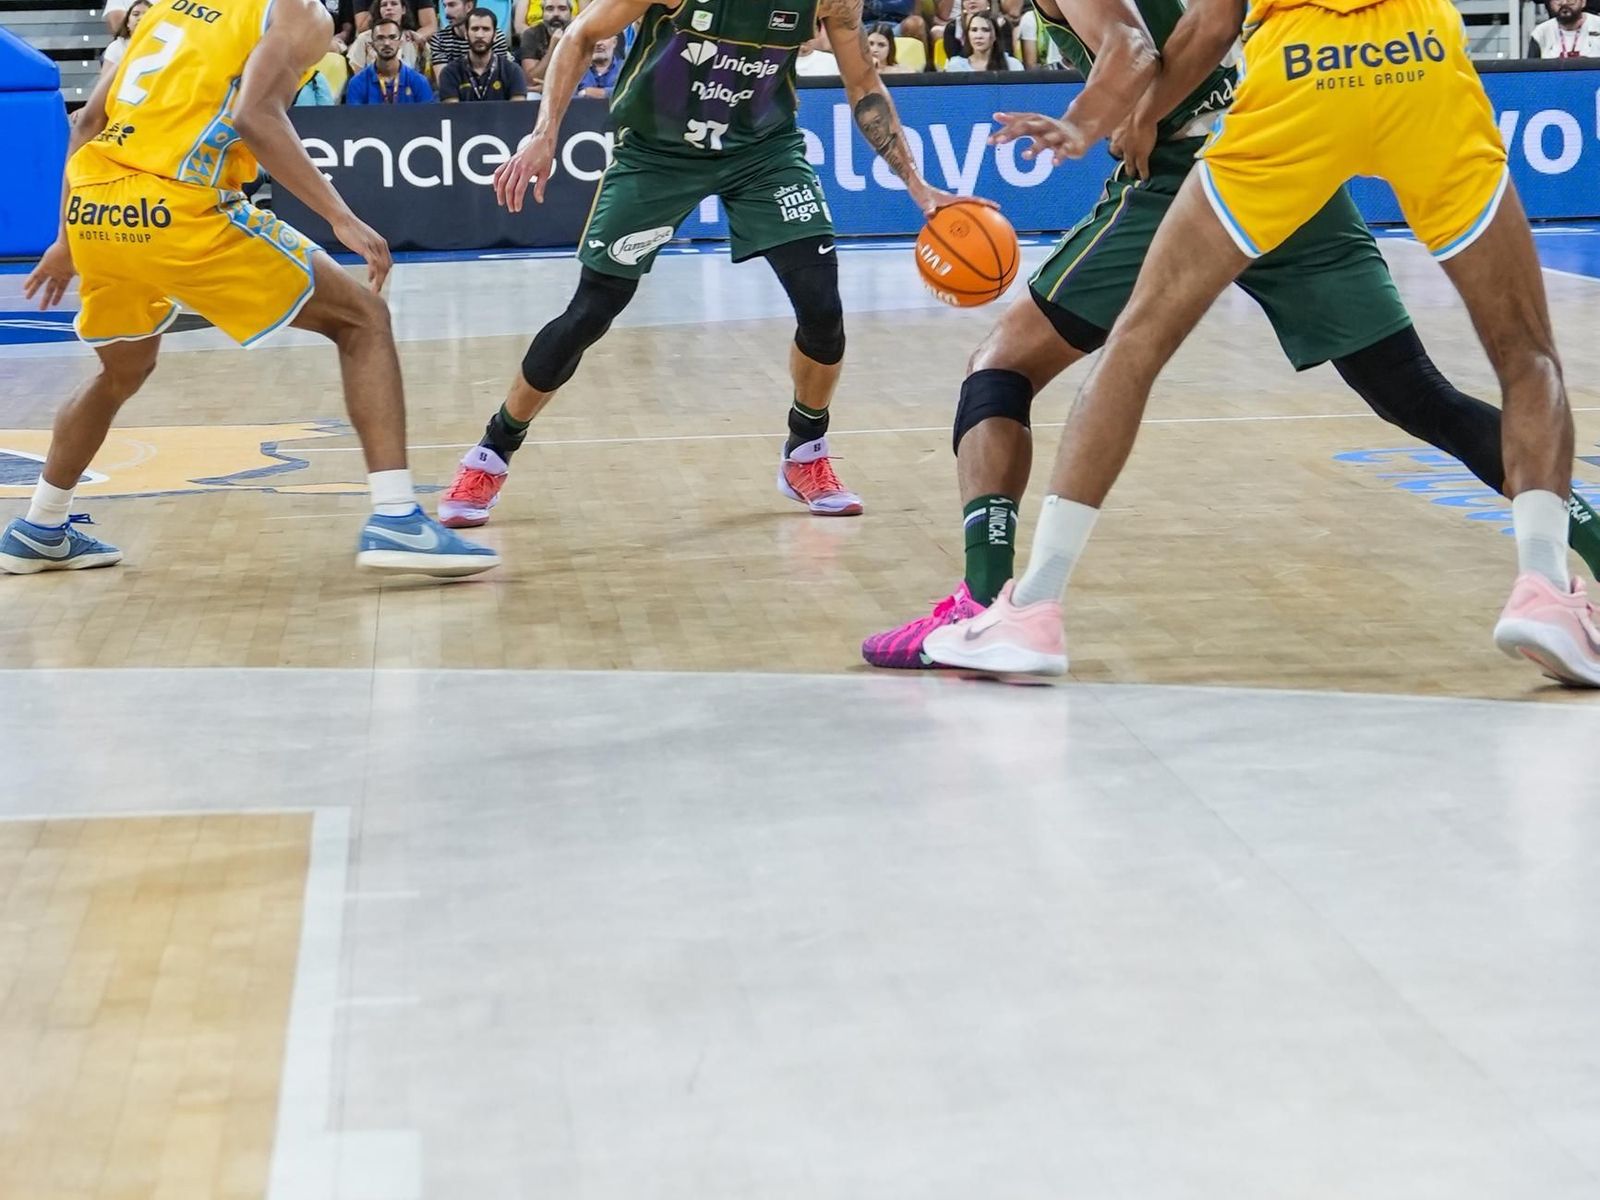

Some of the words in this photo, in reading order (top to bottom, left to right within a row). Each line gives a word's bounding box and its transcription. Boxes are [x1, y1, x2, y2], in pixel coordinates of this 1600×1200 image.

[117, 21, 185, 106] 2
[712, 54, 780, 79] Unicaja
[1283, 29, 1445, 81] Barceló
[1316, 75, 1365, 90] HOTEL
[1374, 69, 1426, 85] GROUP
[684, 118, 729, 150] 27
[68, 195, 172, 228] Barceló
[79, 230, 111, 241] HOTEL
[115, 232, 152, 244] GROUP
